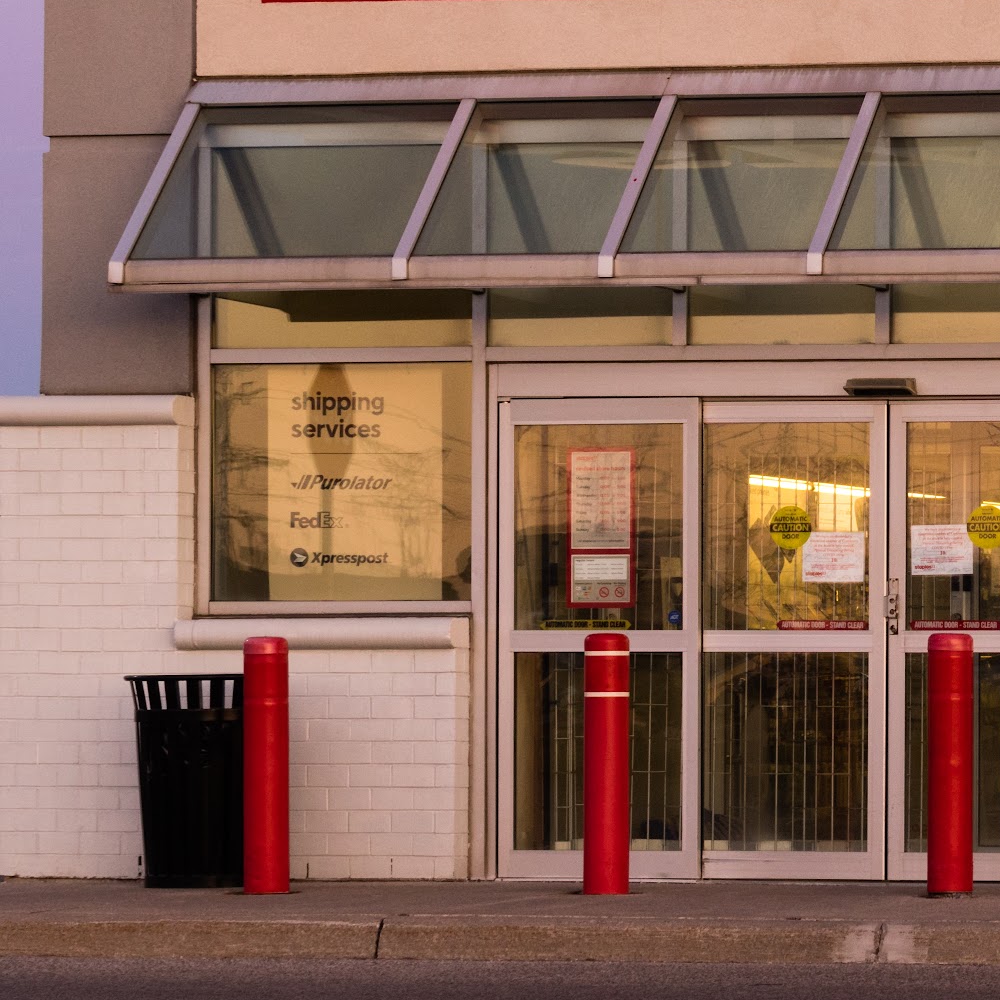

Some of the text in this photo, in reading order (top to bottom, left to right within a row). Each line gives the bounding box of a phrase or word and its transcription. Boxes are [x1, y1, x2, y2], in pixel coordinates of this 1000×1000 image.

[291, 391, 385, 416] shipping
[291, 418, 382, 438] services
[309, 474, 393, 490] Purolator
[290, 511, 344, 529] FedEx
[774, 515, 808, 523] AUTOMATIC
[772, 524, 809, 532] CAUTION
[311, 551, 389, 567] Xpresspost
[914, 621, 944, 629] AUTOMATIC
[944, 621, 959, 629] DOOR
[962, 621, 979, 629] STAND
[980, 621, 998, 629] CLEAR
